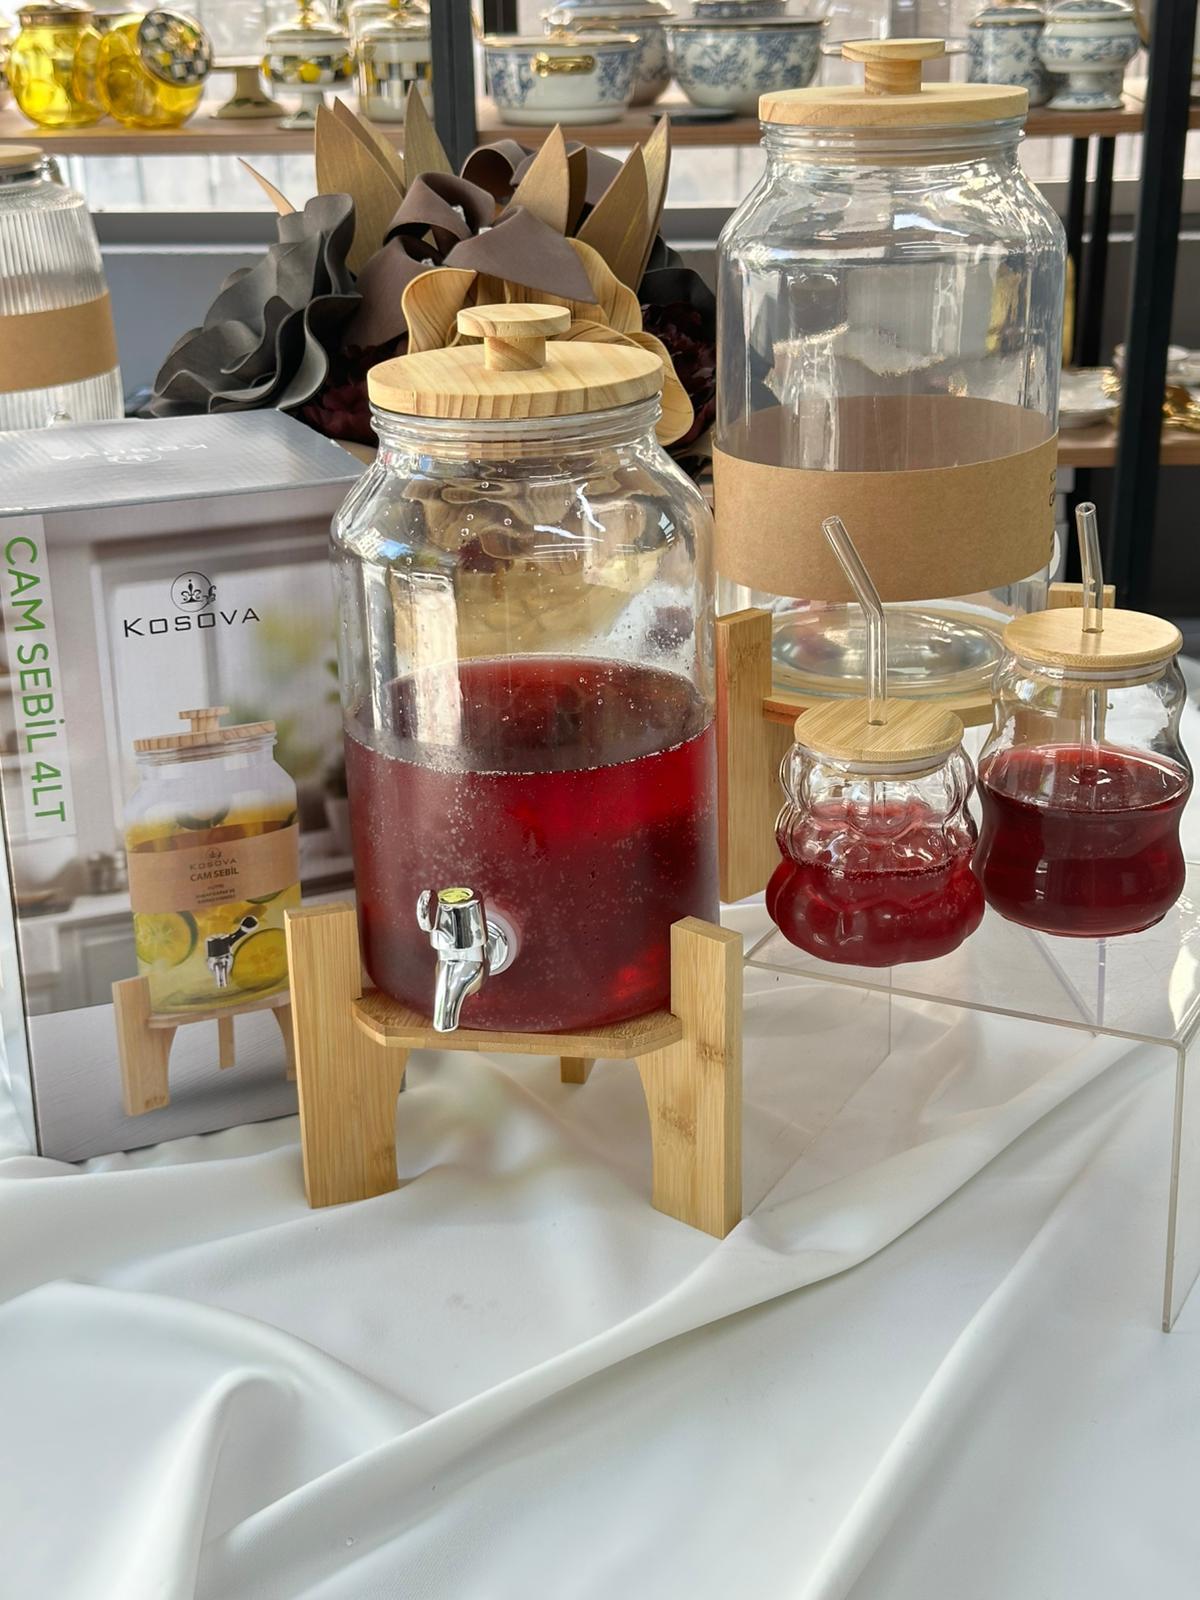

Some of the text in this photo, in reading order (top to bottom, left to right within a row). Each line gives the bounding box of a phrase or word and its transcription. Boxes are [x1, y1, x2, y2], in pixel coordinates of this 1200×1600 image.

[123, 608, 260, 638] KOSOVA
[5, 536, 66, 822] CAM SEBİL 4LT
[190, 858, 237, 870] KOSOVA
[190, 866, 239, 881] CAM SEBİL
